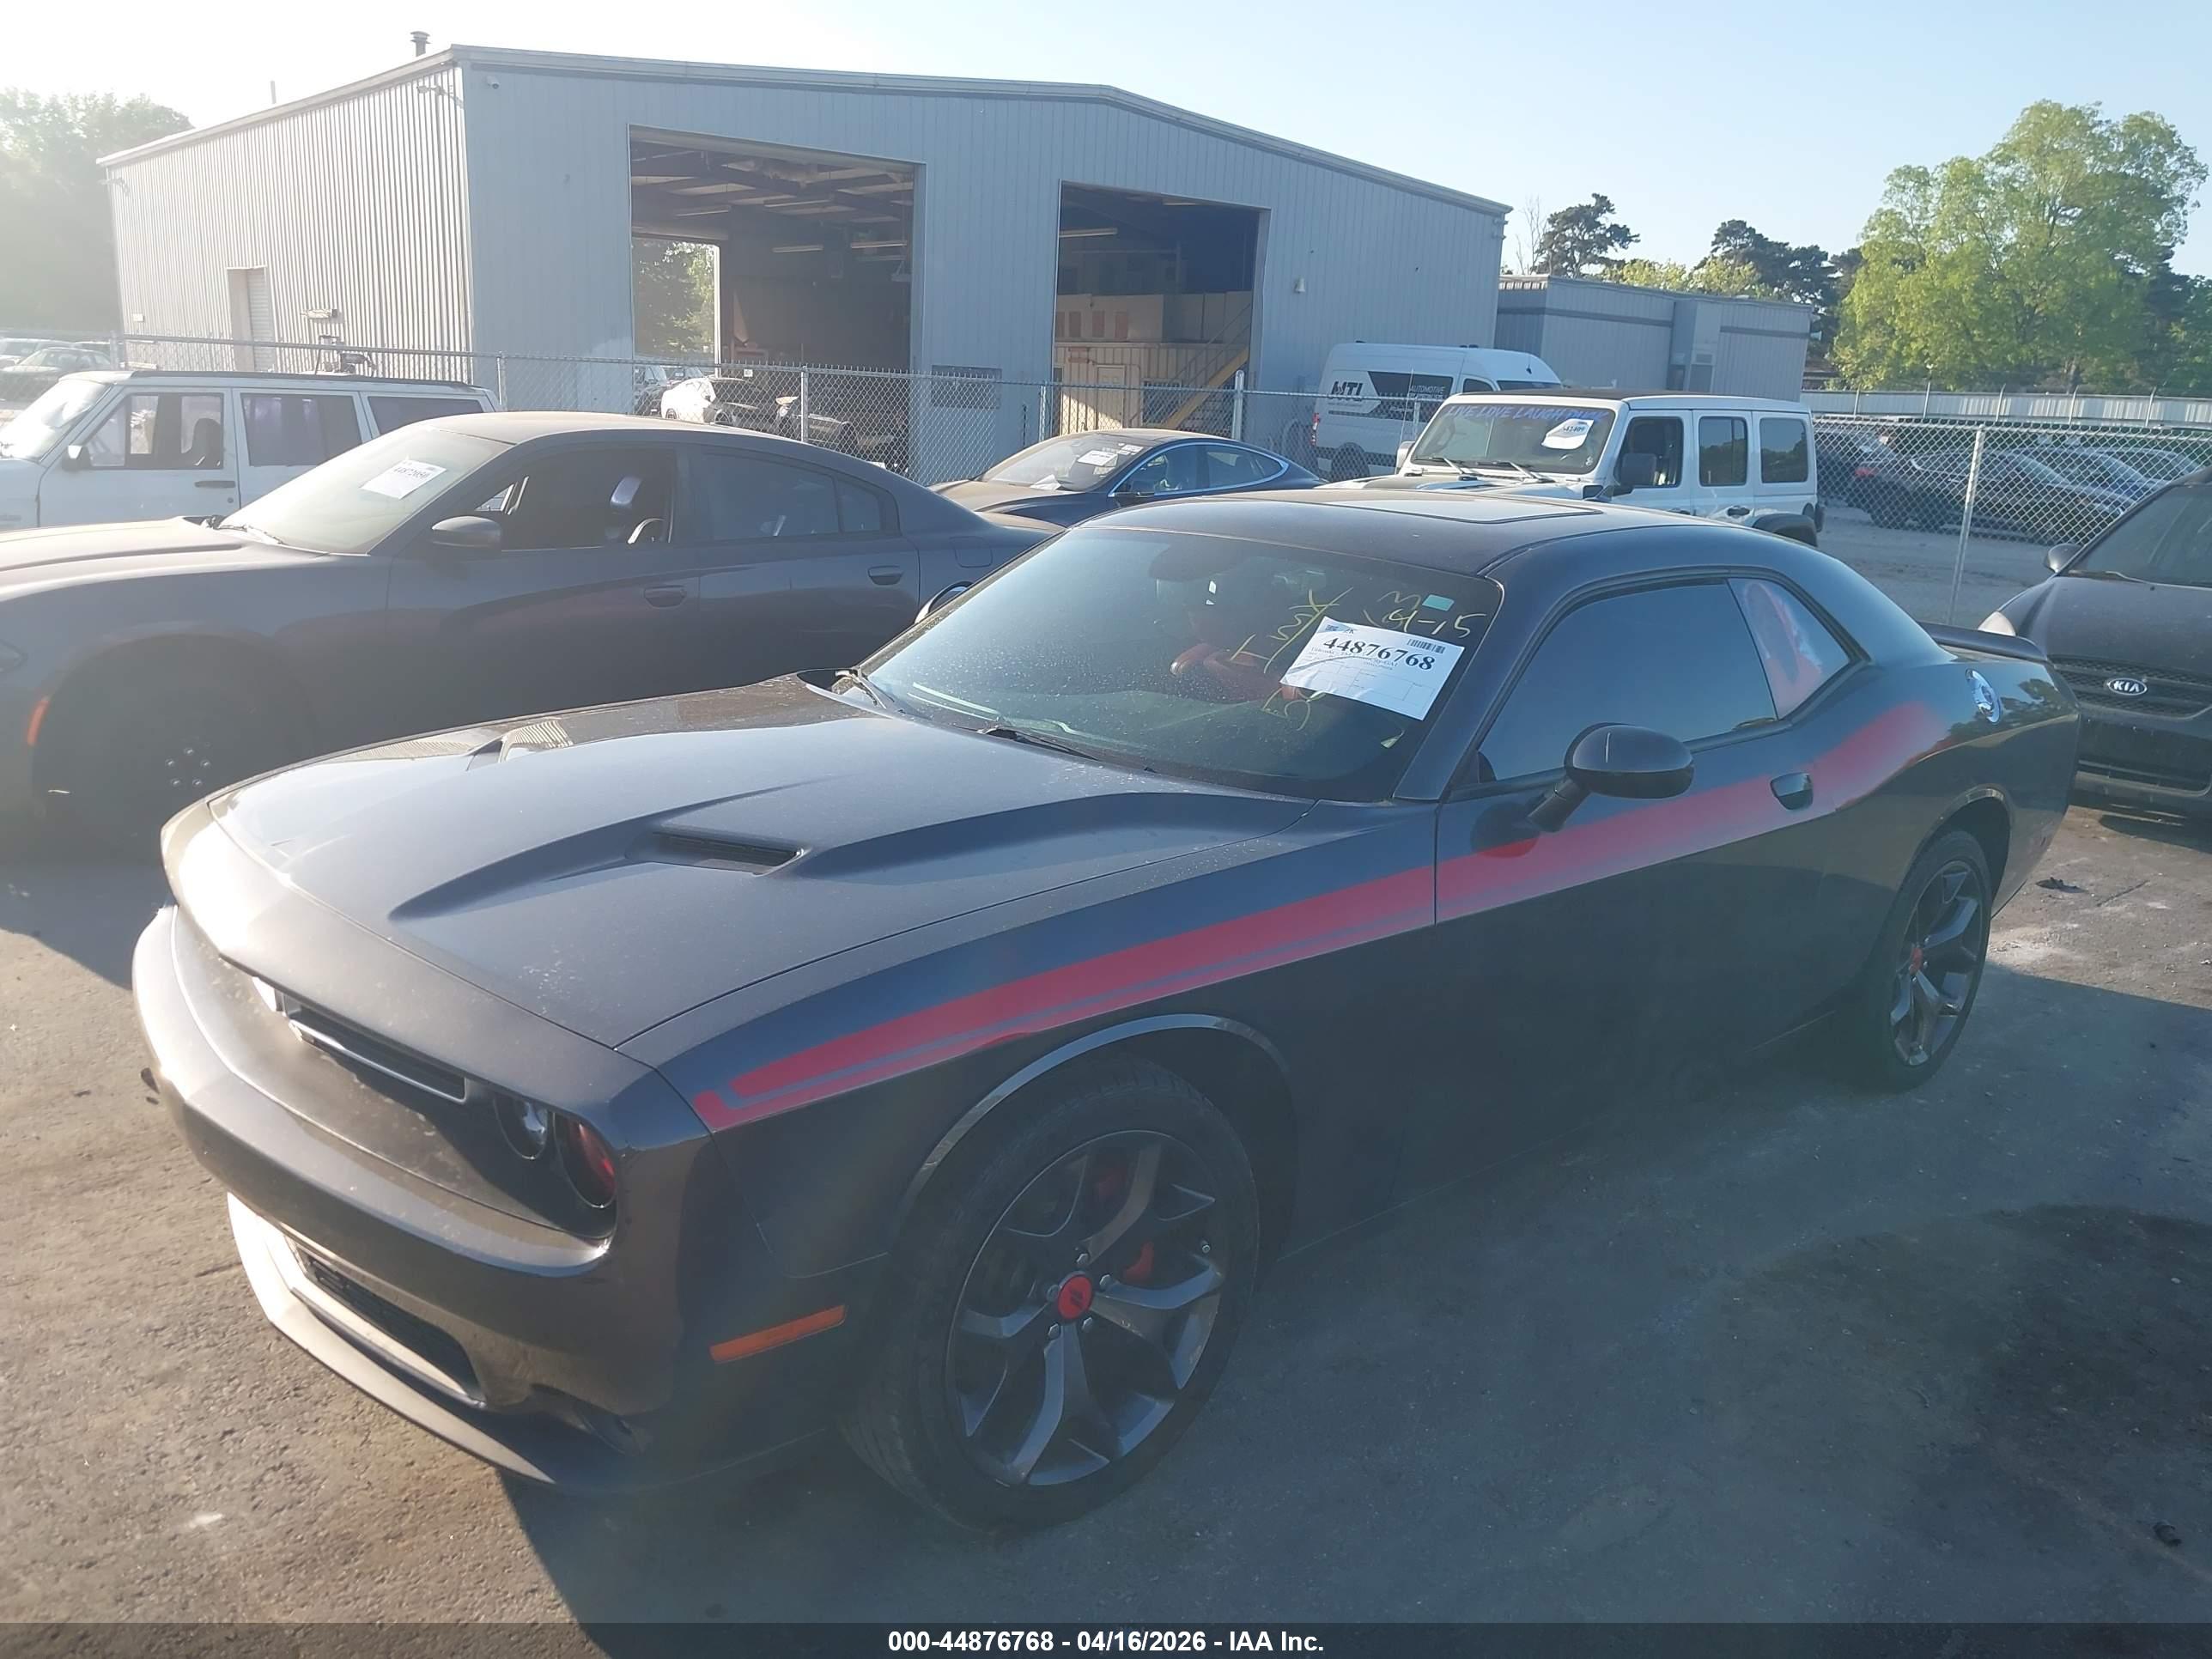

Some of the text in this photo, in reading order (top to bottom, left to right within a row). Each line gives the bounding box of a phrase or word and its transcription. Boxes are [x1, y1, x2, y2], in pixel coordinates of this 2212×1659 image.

[1446, 405, 1479, 416] LIVE
[1477, 406, 1515, 418] LOVE
[1513, 407, 1565, 420] LAUGH
[1322, 637, 1436, 671] 44876768
[2113, 680, 2140, 692] KIA
